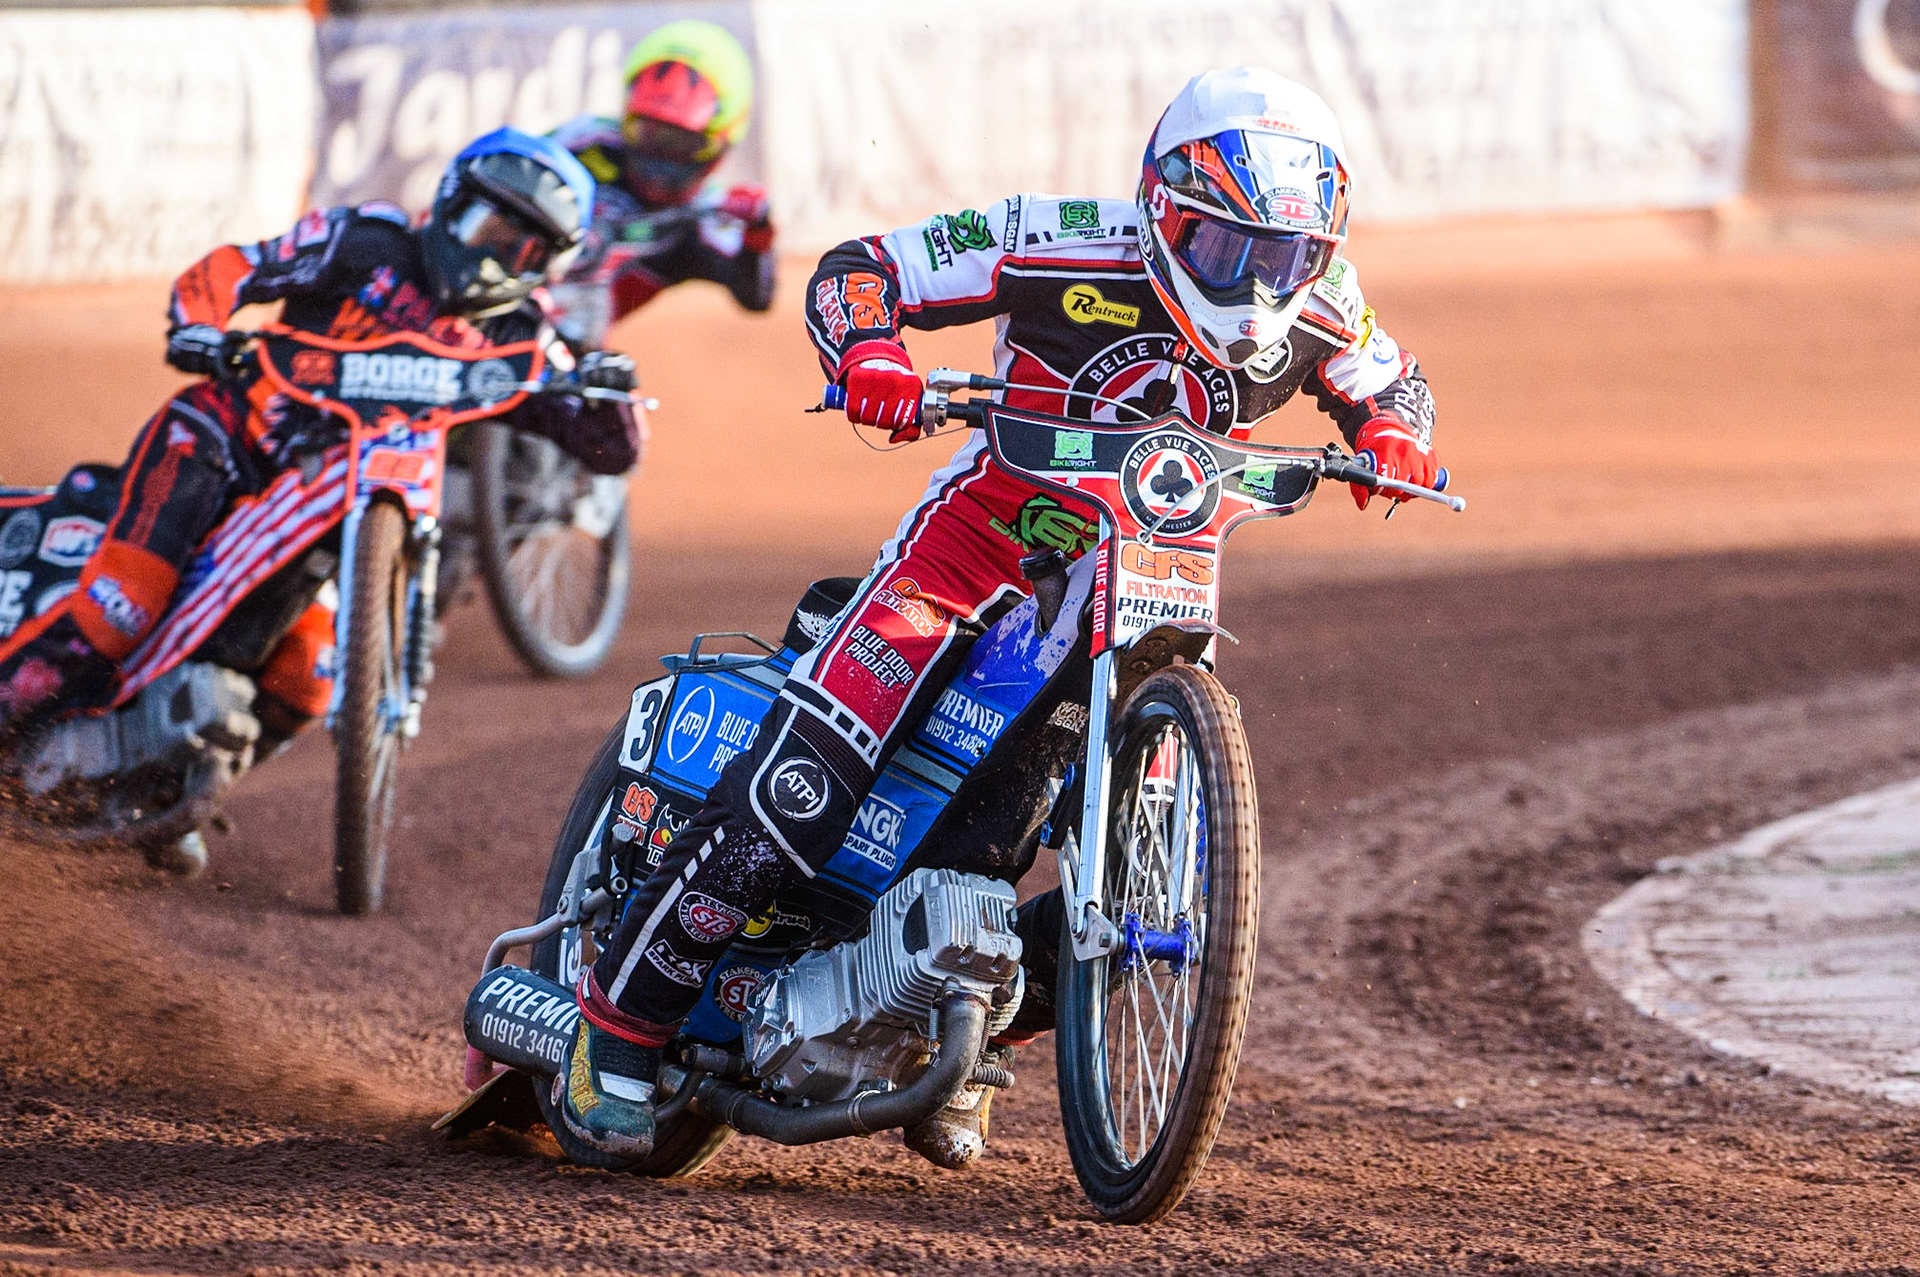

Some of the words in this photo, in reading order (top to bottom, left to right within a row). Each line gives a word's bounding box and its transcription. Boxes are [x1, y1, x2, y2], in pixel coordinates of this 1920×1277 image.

[1271, 200, 1317, 217] STS
[1071, 292, 1136, 322] Rentruck
[1089, 342, 1149, 382] BELLE
[1162, 341, 1199, 366] VE
[1202, 368, 1230, 412] ACES
[1129, 438, 1160, 469] BELLE
[1165, 437, 1191, 451] VUE
[1193, 449, 1217, 479] ACES
[1096, 549, 1107, 586] BLUE
[1121, 543, 1214, 585] CFS
[1117, 597, 1213, 622] PREMIER
[1126, 580, 1208, 605] FILTRATION
[1093, 590, 1106, 634] DOOR
[844, 641, 899, 688] PROJECT
[850, 625, 888, 655] BLUE
[881, 648, 915, 685] DOOR
[630, 689, 663, 761] 3
[676, 711, 705, 738] ATPI
[716, 711, 751, 746] BLUE
[925, 715, 955, 743] 01912
[623, 782, 657, 823] CFS
[780, 771, 819, 810] ATPI
[851, 802, 900, 850] NGK
[844, 836, 870, 854] PARK
[870, 845, 896, 868] PLUGS
[694, 911, 730, 933] STS
[649, 951, 676, 975] SPARK
[719, 966, 765, 982] STAKEFO
[728, 980, 756, 1006] ST
[482, 1013, 525, 1049] 01912
